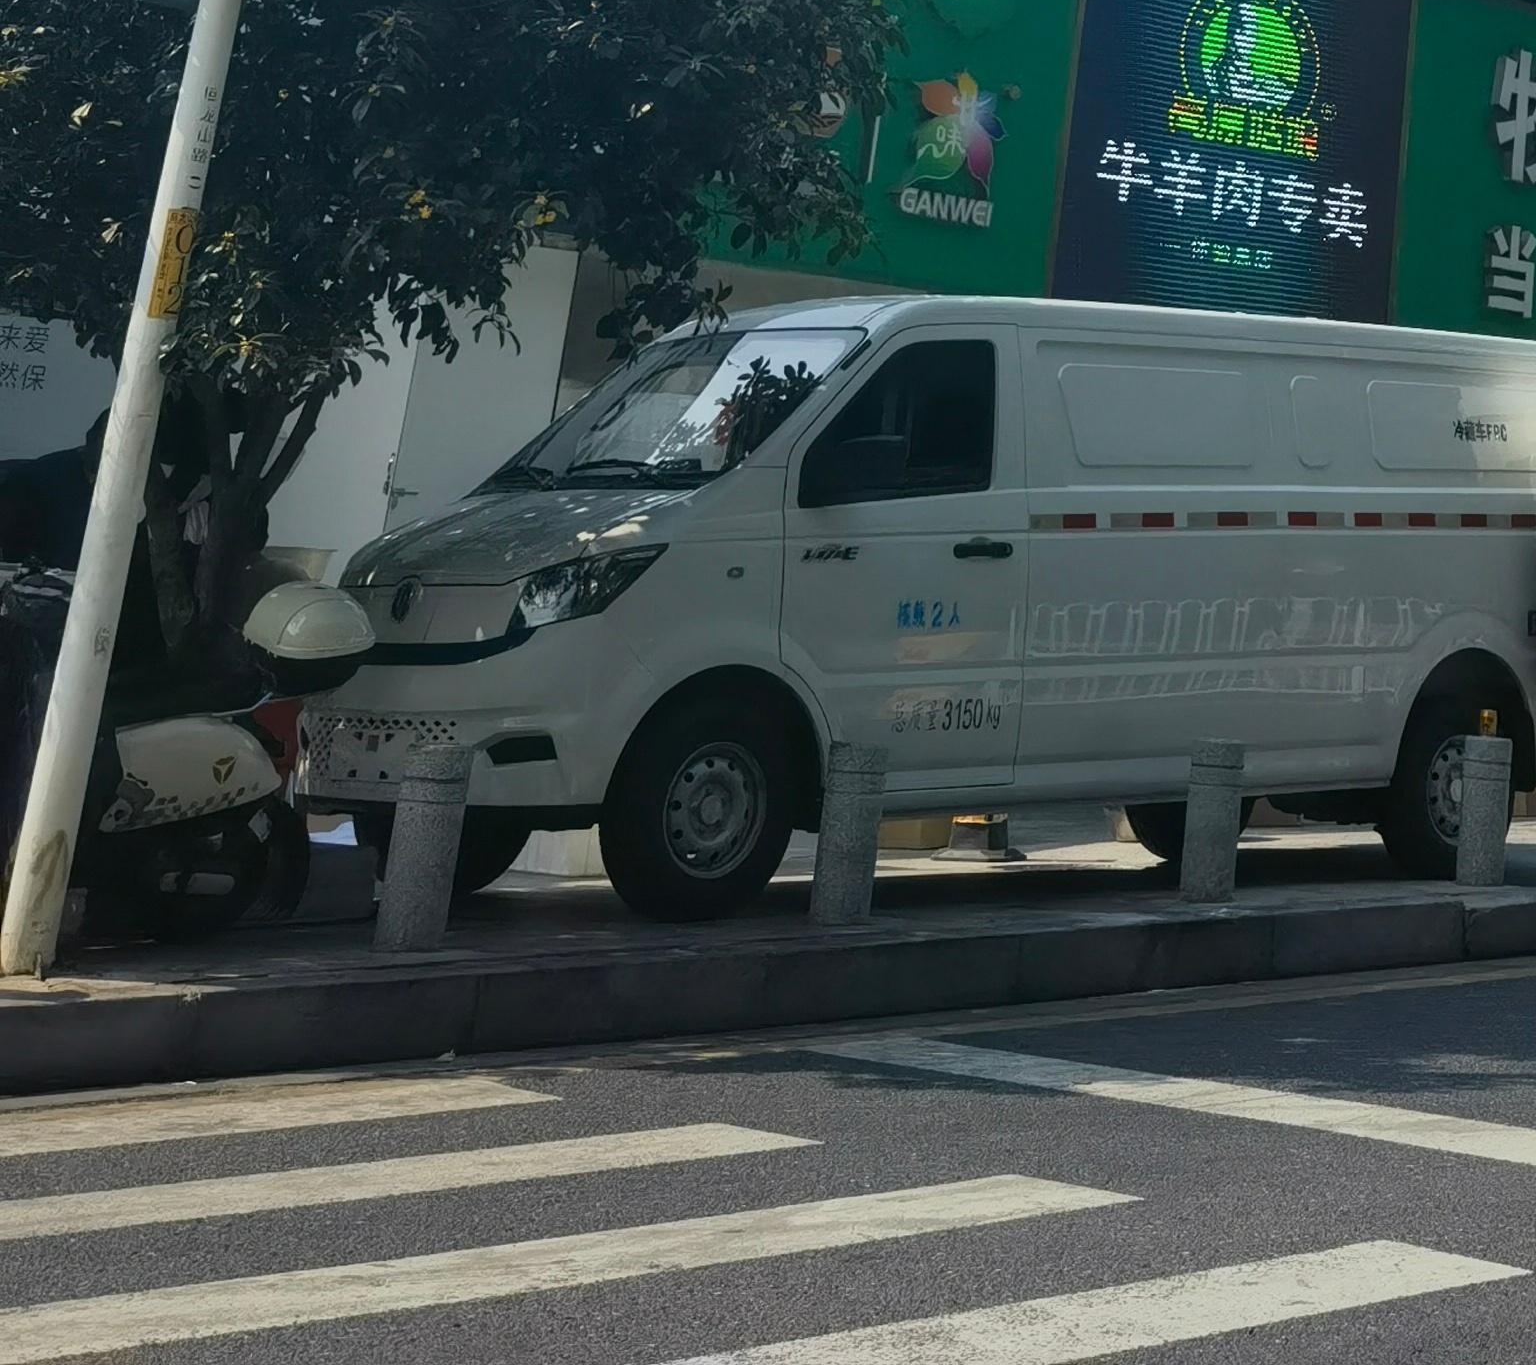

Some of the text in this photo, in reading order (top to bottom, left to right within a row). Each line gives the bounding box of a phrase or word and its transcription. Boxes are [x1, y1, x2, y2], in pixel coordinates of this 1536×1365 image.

[900, 187, 994, 228] GANWEI
[1096, 138, 1368, 249] 牛羊肉专卖
